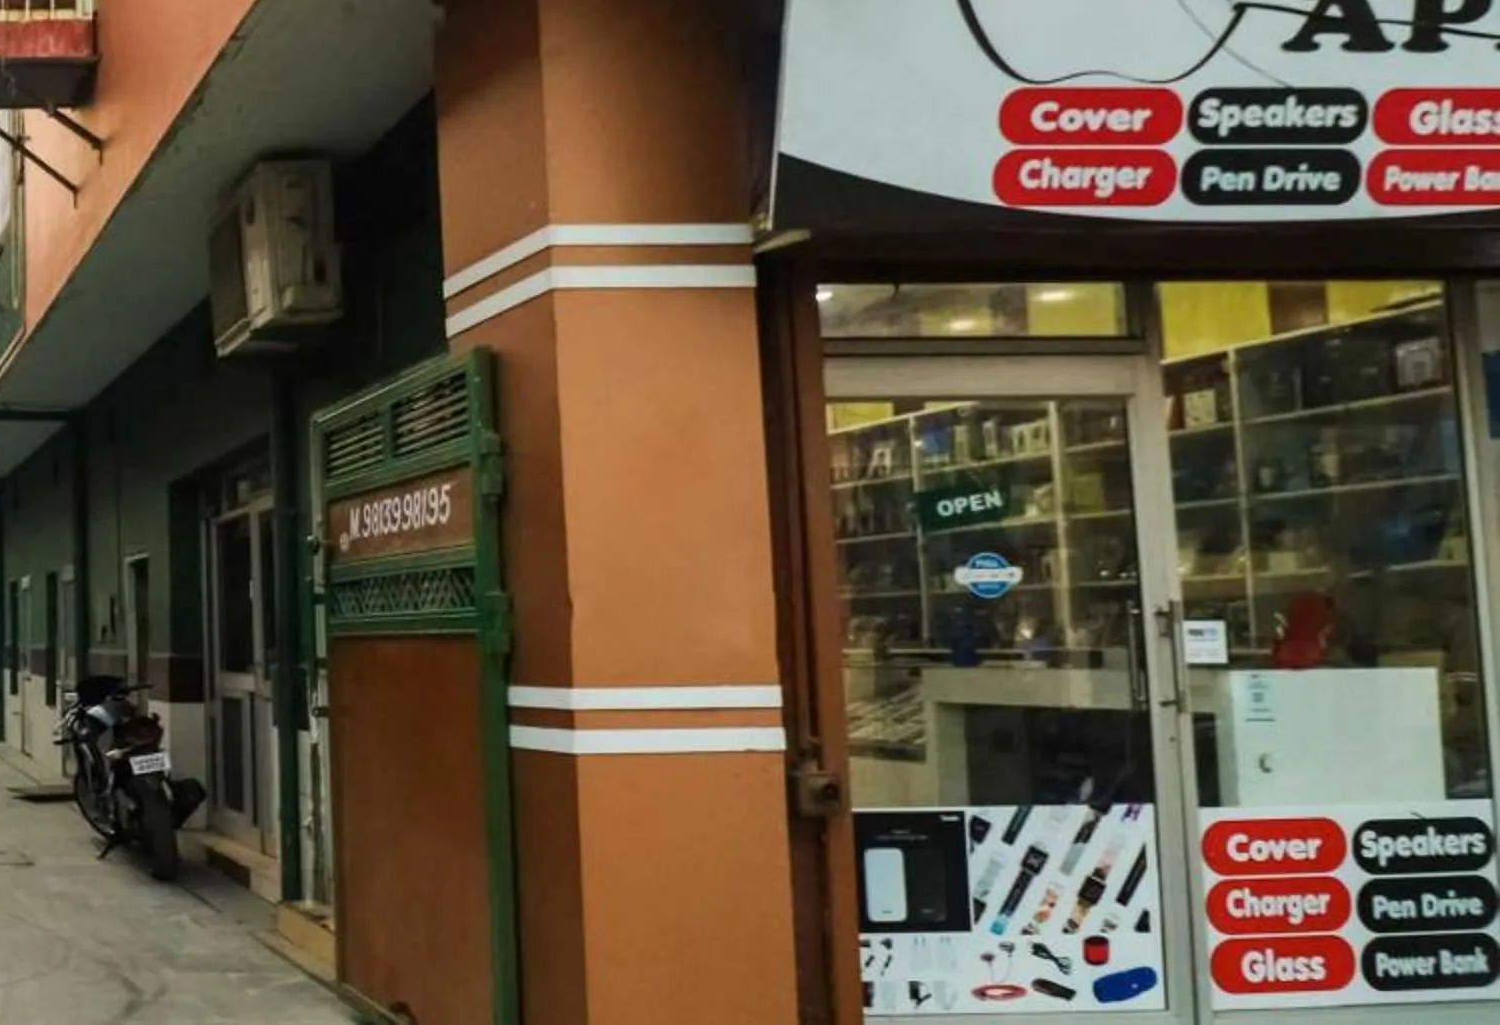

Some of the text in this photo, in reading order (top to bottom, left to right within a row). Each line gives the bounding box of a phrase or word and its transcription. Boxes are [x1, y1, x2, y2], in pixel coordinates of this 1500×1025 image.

[1030, 101, 1153, 133] Cover
[1197, 95, 1359, 137] Speakers
[1018, 157, 1153, 199] Charger
[1201, 162, 1341, 192] Pen Drive
[1383, 165, 1461, 192] Power
[936, 489, 1003, 516] OPEN
[1226, 833, 1323, 862] Cover
[1360, 827, 1487, 867] Speakers
[1226, 887, 1331, 925] Charger
[1372, 890, 1484, 920] Pen Drive
[1241, 948, 1326, 983] Glass
[1375, 946, 1490, 979] Power Bank
